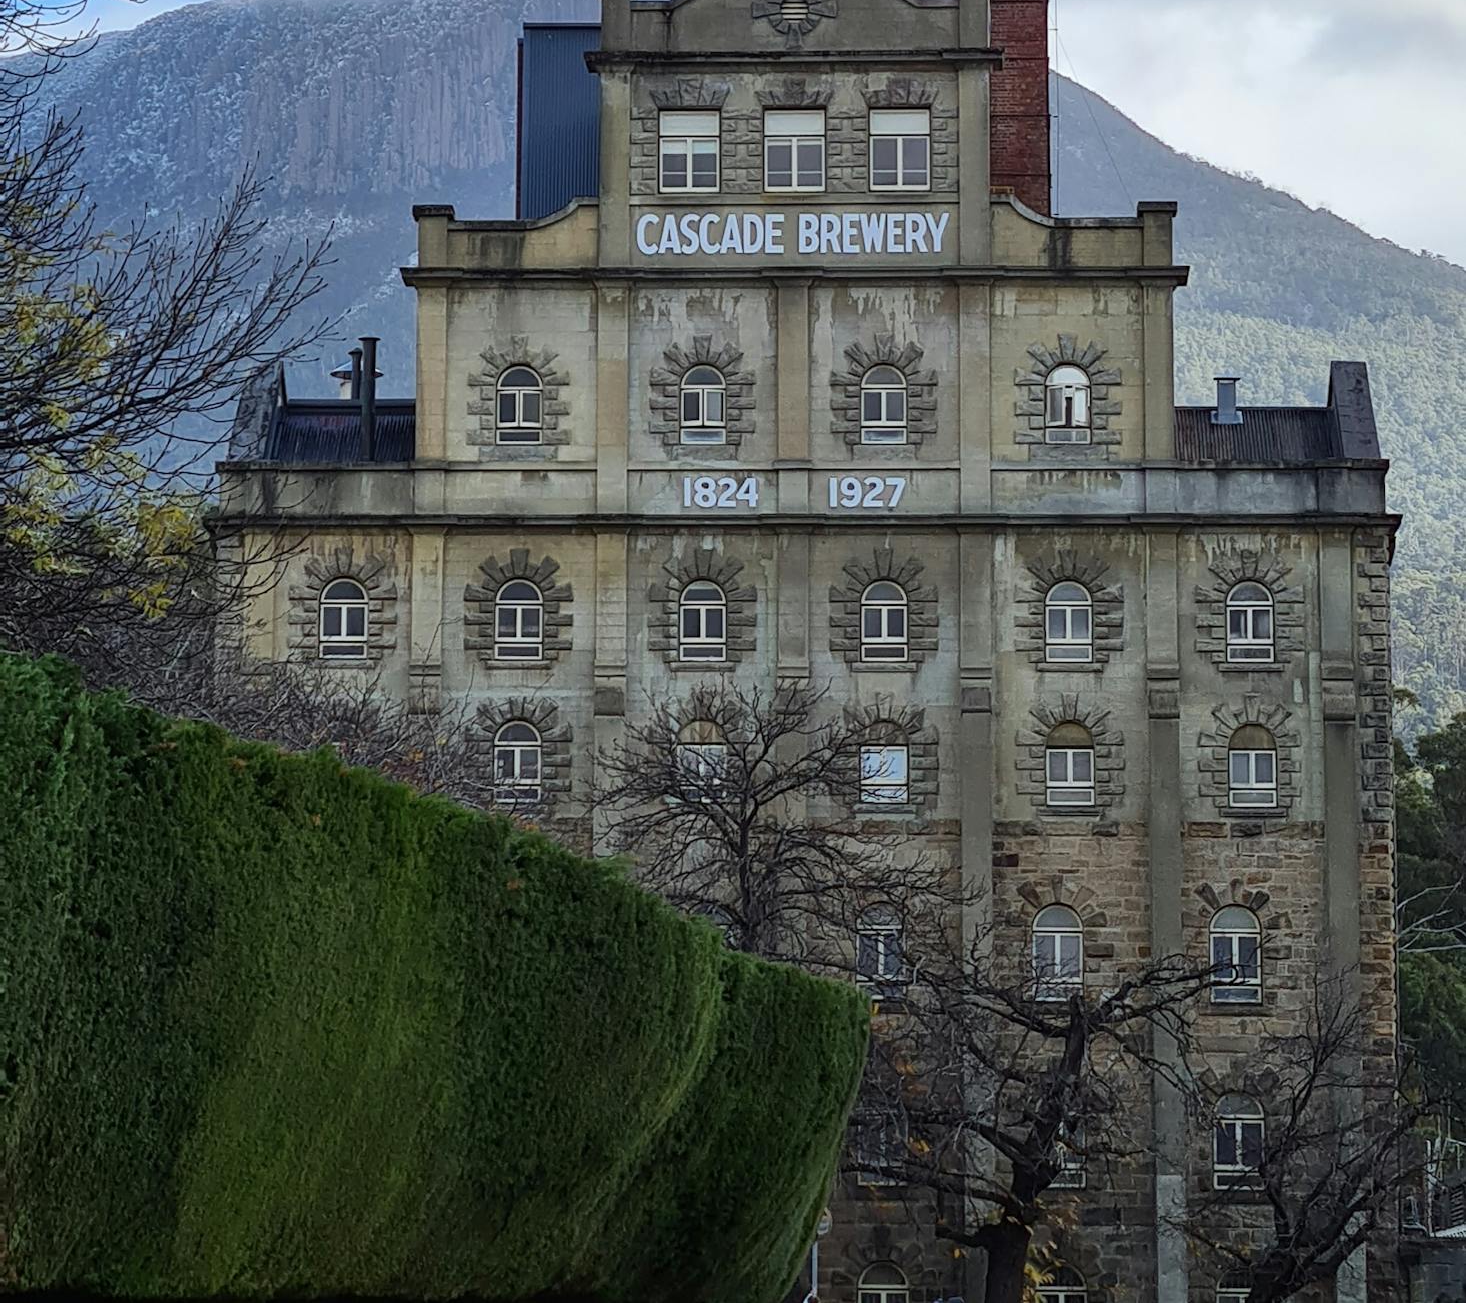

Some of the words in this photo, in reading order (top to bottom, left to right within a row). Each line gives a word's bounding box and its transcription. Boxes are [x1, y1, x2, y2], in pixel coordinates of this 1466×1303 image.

[637, 214, 785, 255] CASCADE
[798, 212, 950, 254] BREWERY
[683, 476, 759, 508] 1824
[829, 476, 906, 508] 1927
